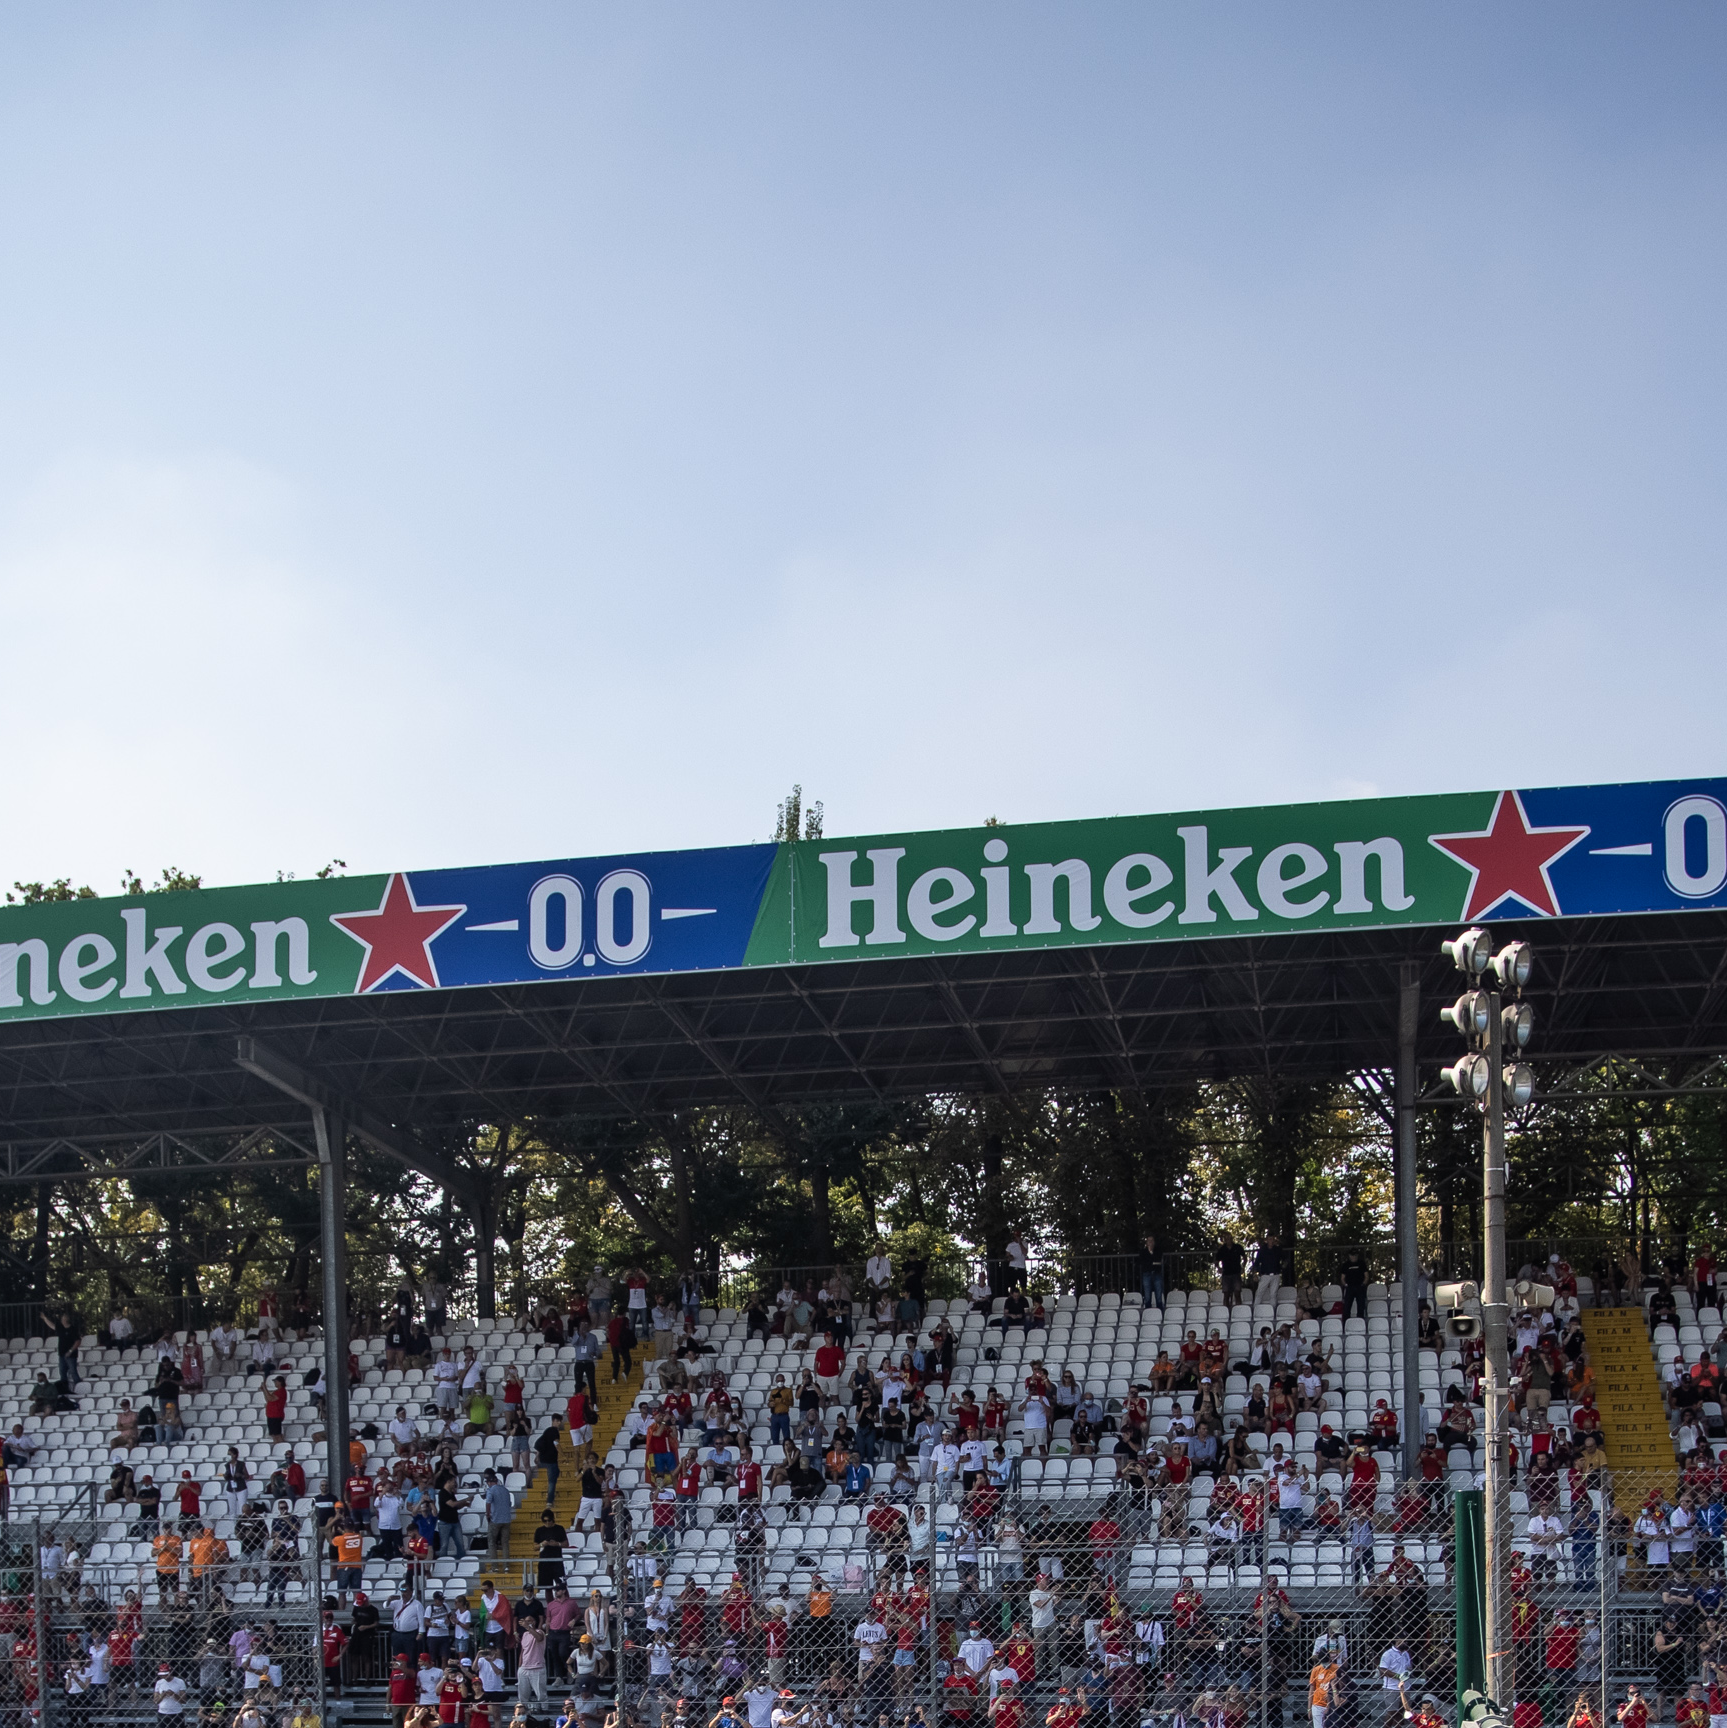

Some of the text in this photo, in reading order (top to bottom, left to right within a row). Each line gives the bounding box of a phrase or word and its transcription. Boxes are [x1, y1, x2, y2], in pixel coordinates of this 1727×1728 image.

[819, 826, 1415, 948] Heineken
[528, 867, 652, 968] 0.0
[1609, 1384, 1630, 1392] FILA
[1617, 1424, 1638, 1432] FILA
